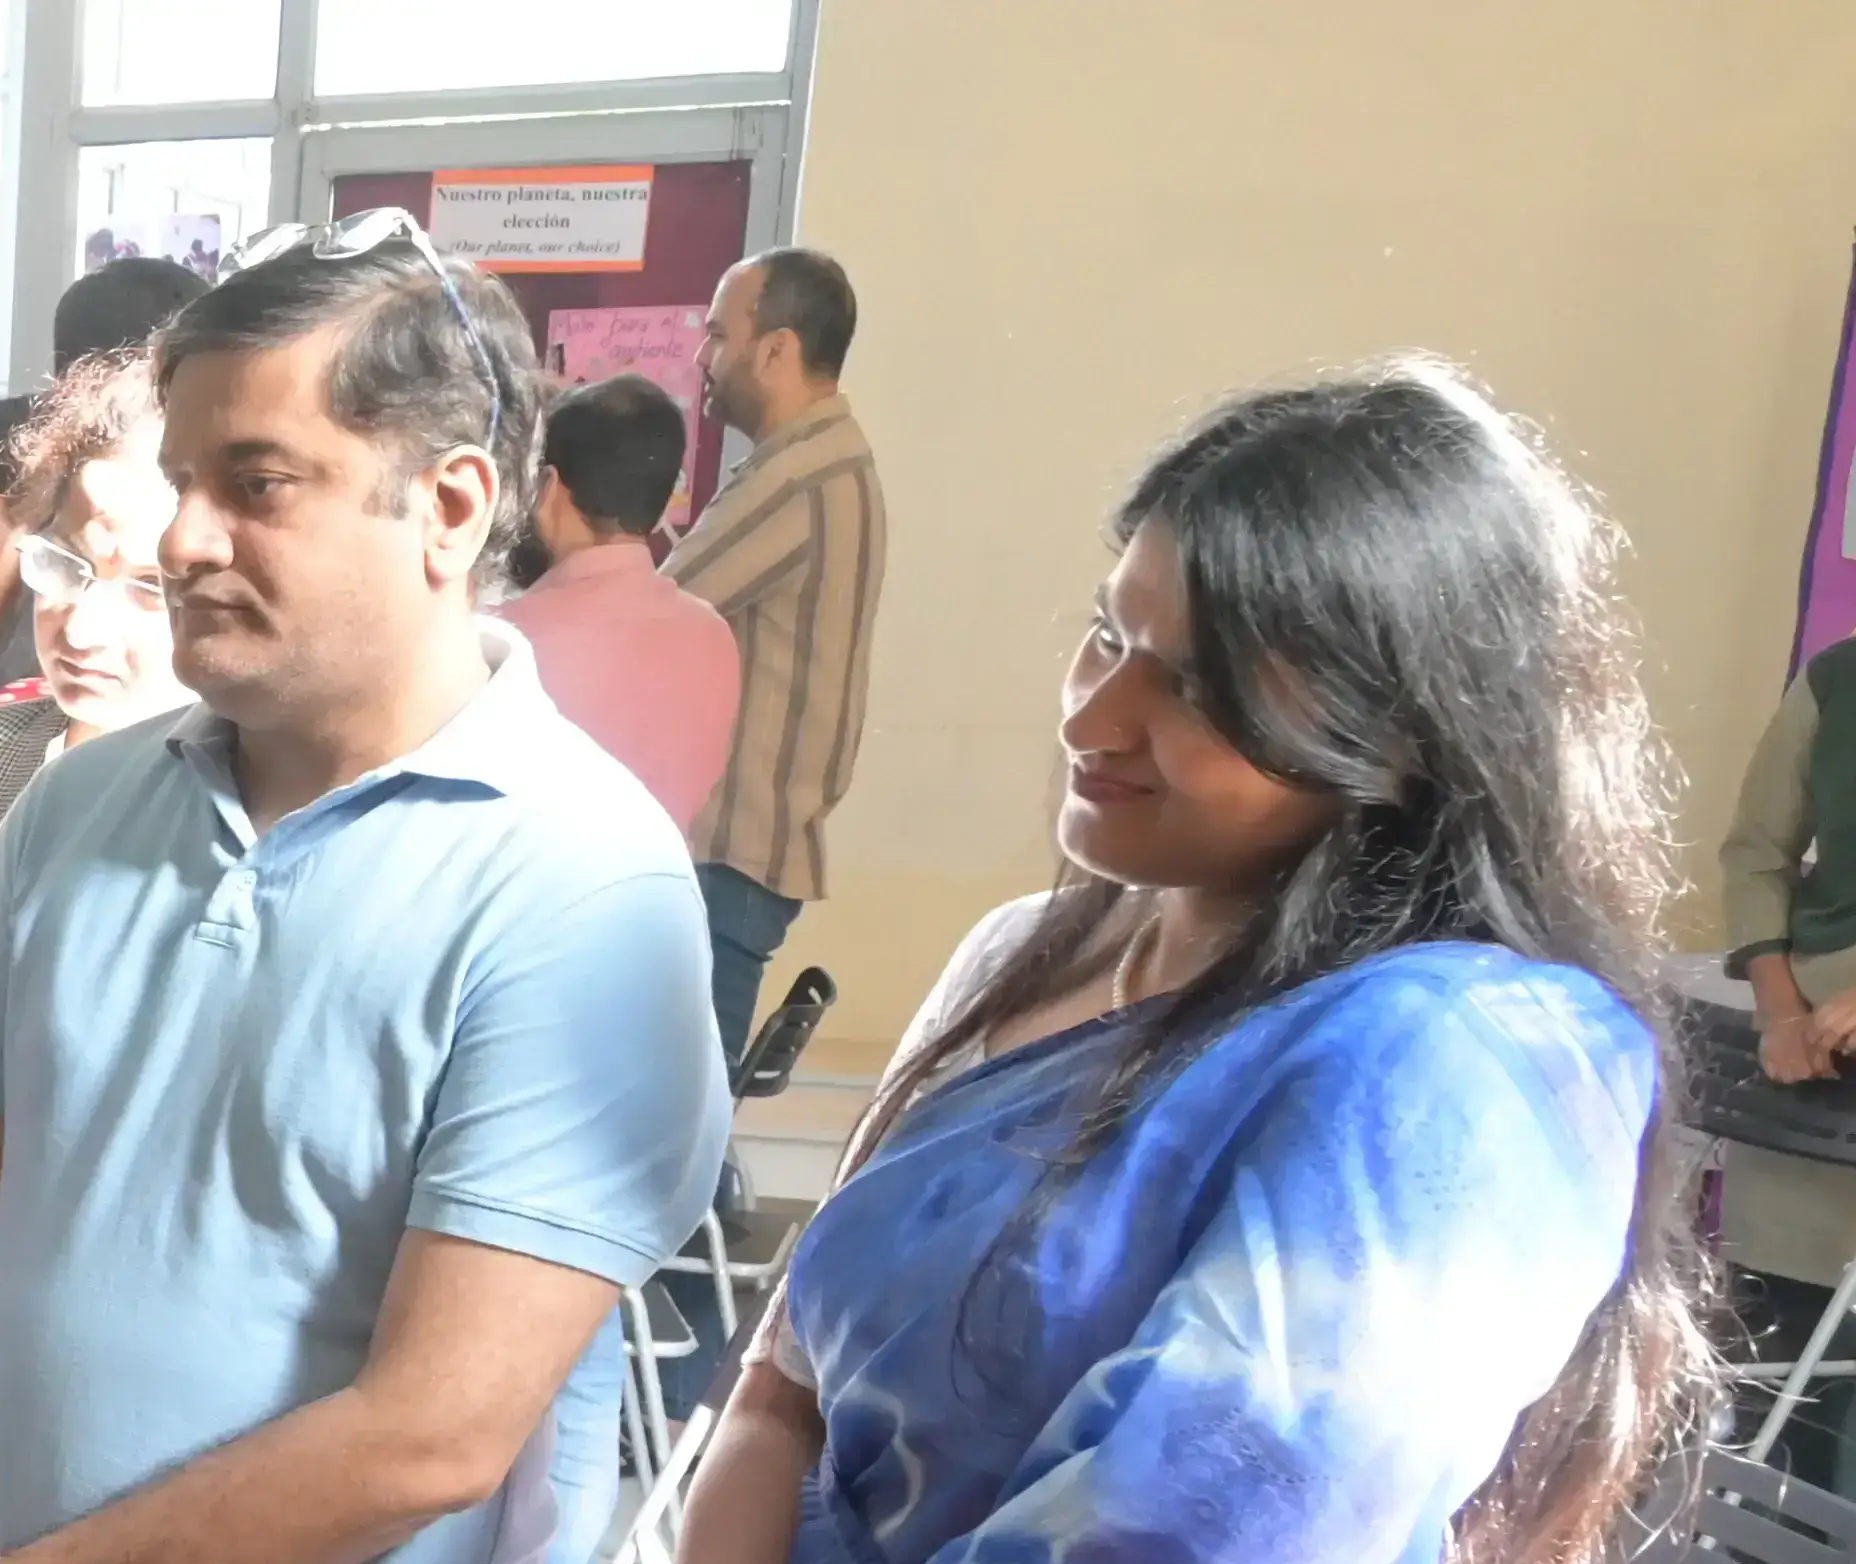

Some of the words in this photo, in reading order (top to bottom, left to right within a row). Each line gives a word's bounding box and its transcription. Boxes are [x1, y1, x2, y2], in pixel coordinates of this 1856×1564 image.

[437, 186, 502, 202] Nuestro
[507, 185, 576, 205] planeta,
[581, 184, 648, 201] nuestra
[503, 213, 570, 229] elección
[485, 239, 534, 255] planet,
[538, 242, 564, 252] our
[567, 238, 620, 254] choice)
